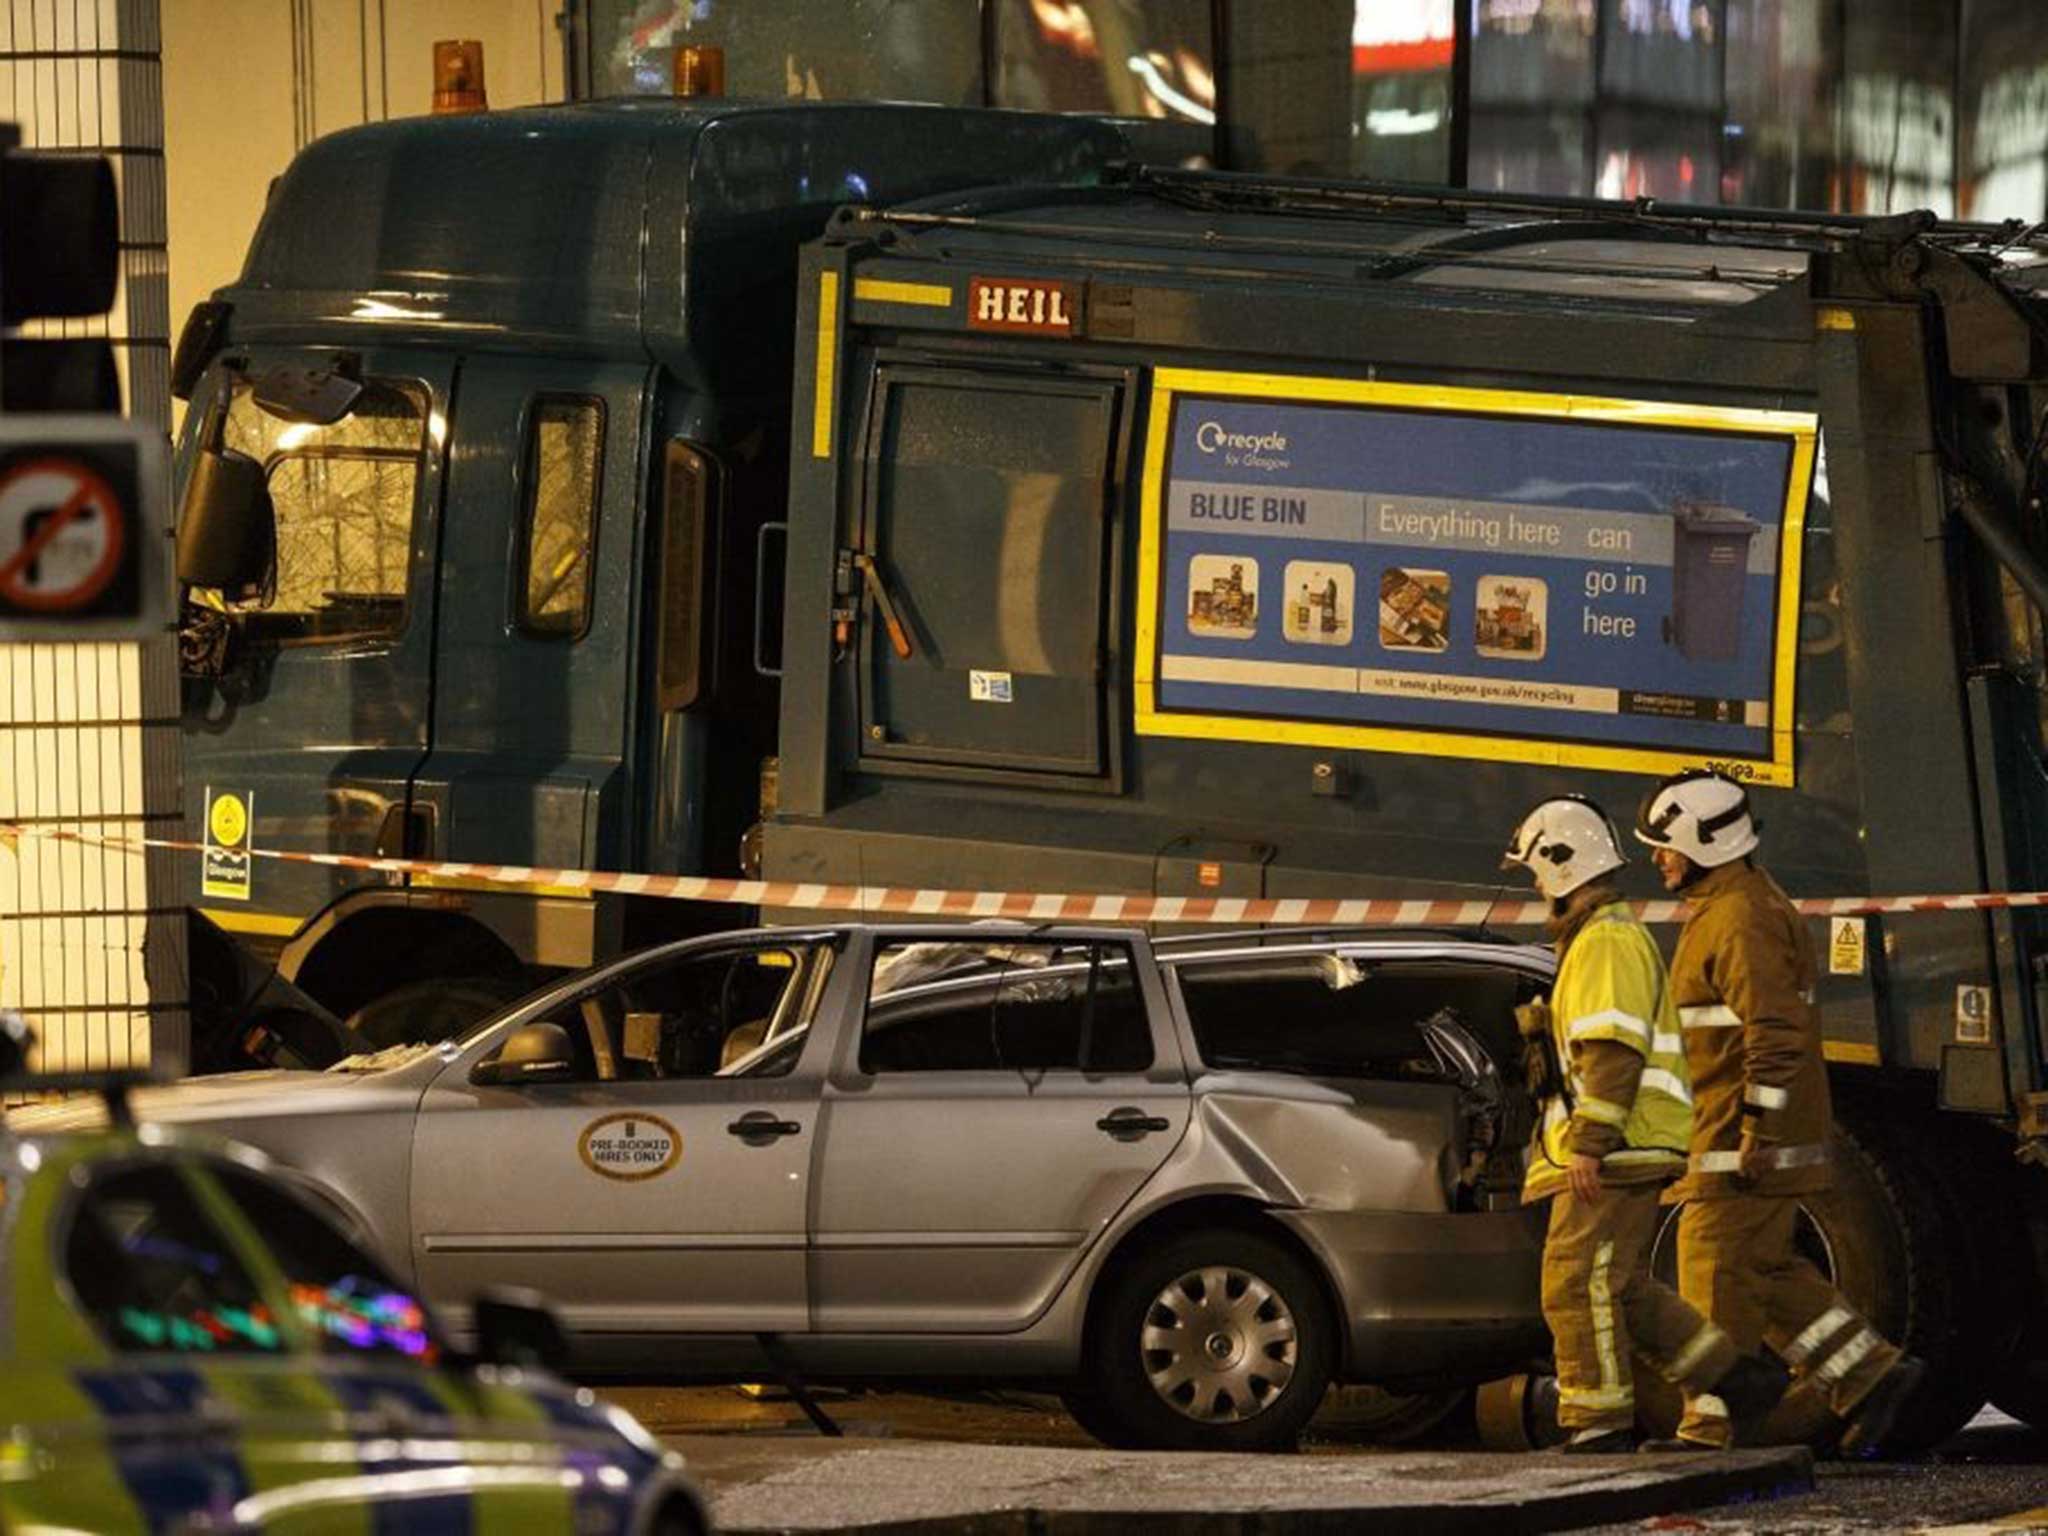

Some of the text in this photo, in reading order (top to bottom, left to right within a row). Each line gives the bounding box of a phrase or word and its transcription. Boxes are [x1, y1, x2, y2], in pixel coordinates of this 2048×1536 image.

[978, 286, 1070, 325] HEIL
[1228, 432, 1287, 454] recycle
[1190, 494, 1306, 525] BLUE BIN
[1380, 505, 1632, 550] Everything here can
[1585, 566, 1646, 598] go in
[1583, 606, 1636, 638] here
[591, 1139, 670, 1150] PRE-BOOKED
[595, 1151, 666, 1162] HIRES ONLY
